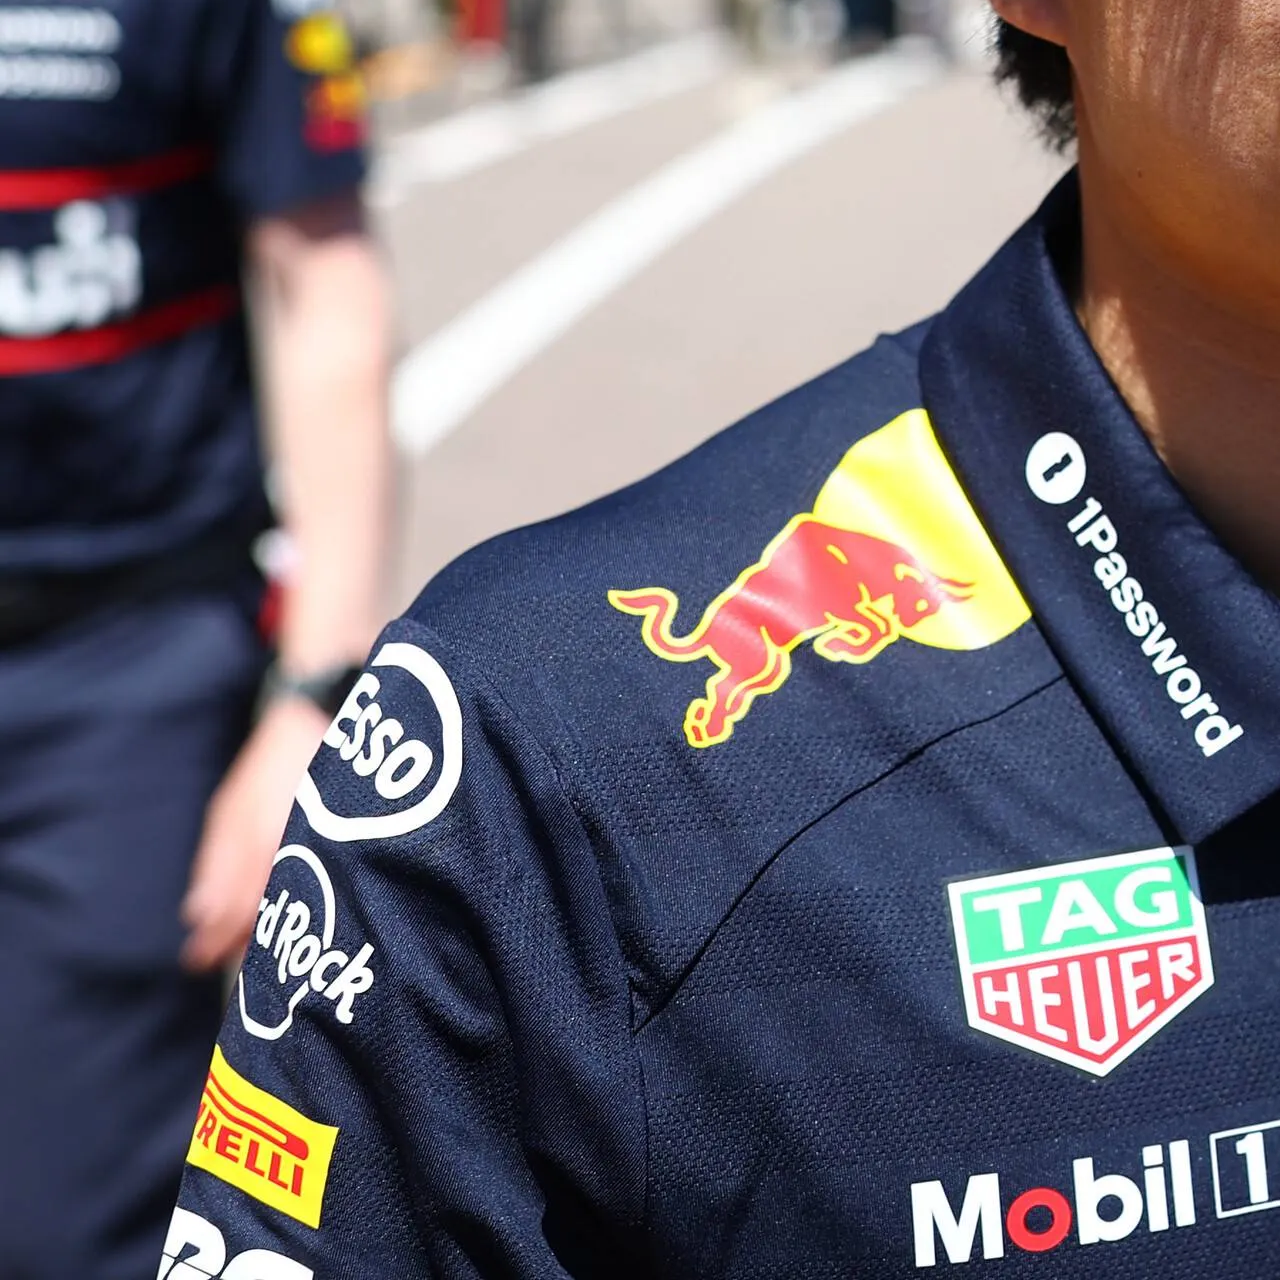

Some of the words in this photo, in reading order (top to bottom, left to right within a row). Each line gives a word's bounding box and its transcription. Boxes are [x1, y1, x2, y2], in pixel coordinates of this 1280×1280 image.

[1066, 497, 1244, 757] 1Password
[972, 866, 1180, 952] TAG
[981, 942, 1196, 1056] HEUER
[910, 1139, 1196, 1268] Mobil
